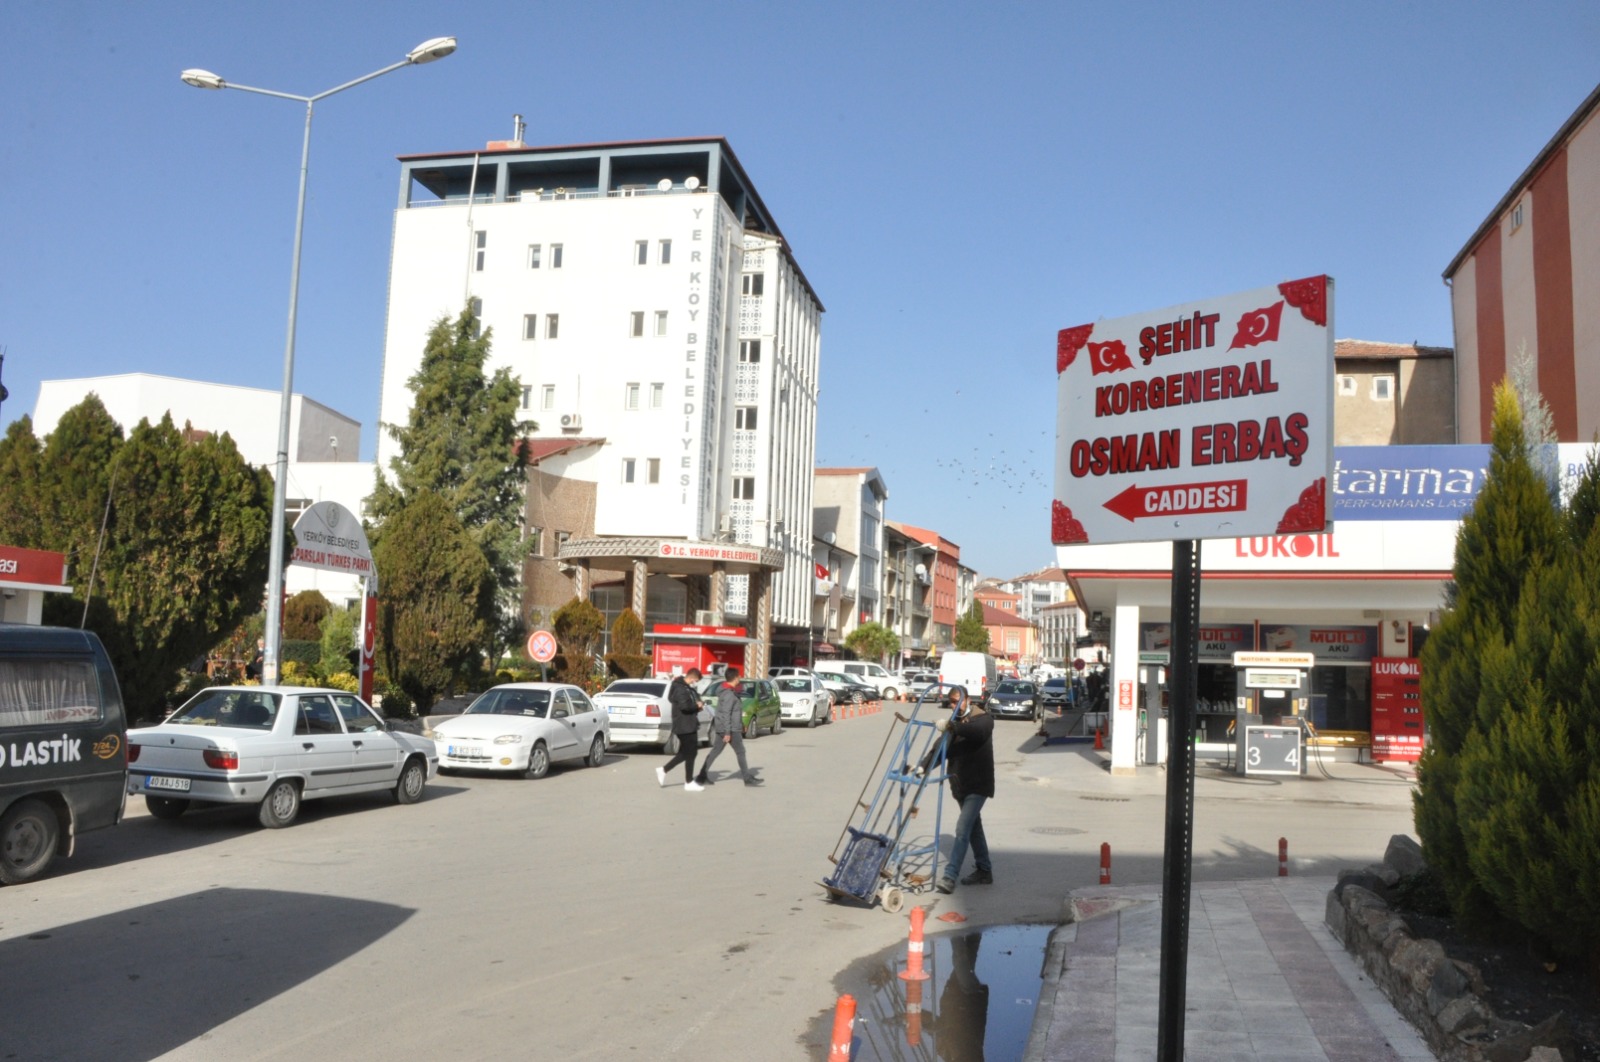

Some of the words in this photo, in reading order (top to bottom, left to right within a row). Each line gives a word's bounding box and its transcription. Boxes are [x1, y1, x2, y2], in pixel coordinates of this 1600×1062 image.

[1139, 310, 1220, 365] ŞEHİT
[1095, 359, 1279, 418] KORGENERAL
[1070, 428, 1181, 478] OSMAN
[1191, 412, 1309, 467] ERBAŞ
[1334, 498, 1435, 508] PERFORMANS
[1236, 533, 1340, 557] LUKOIL
[1375, 661, 1420, 675] LUKOIL
[10, 733, 81, 767] LASTİK
[1248, 746, 1261, 766] 3
[1284, 748, 1298, 767] 4
